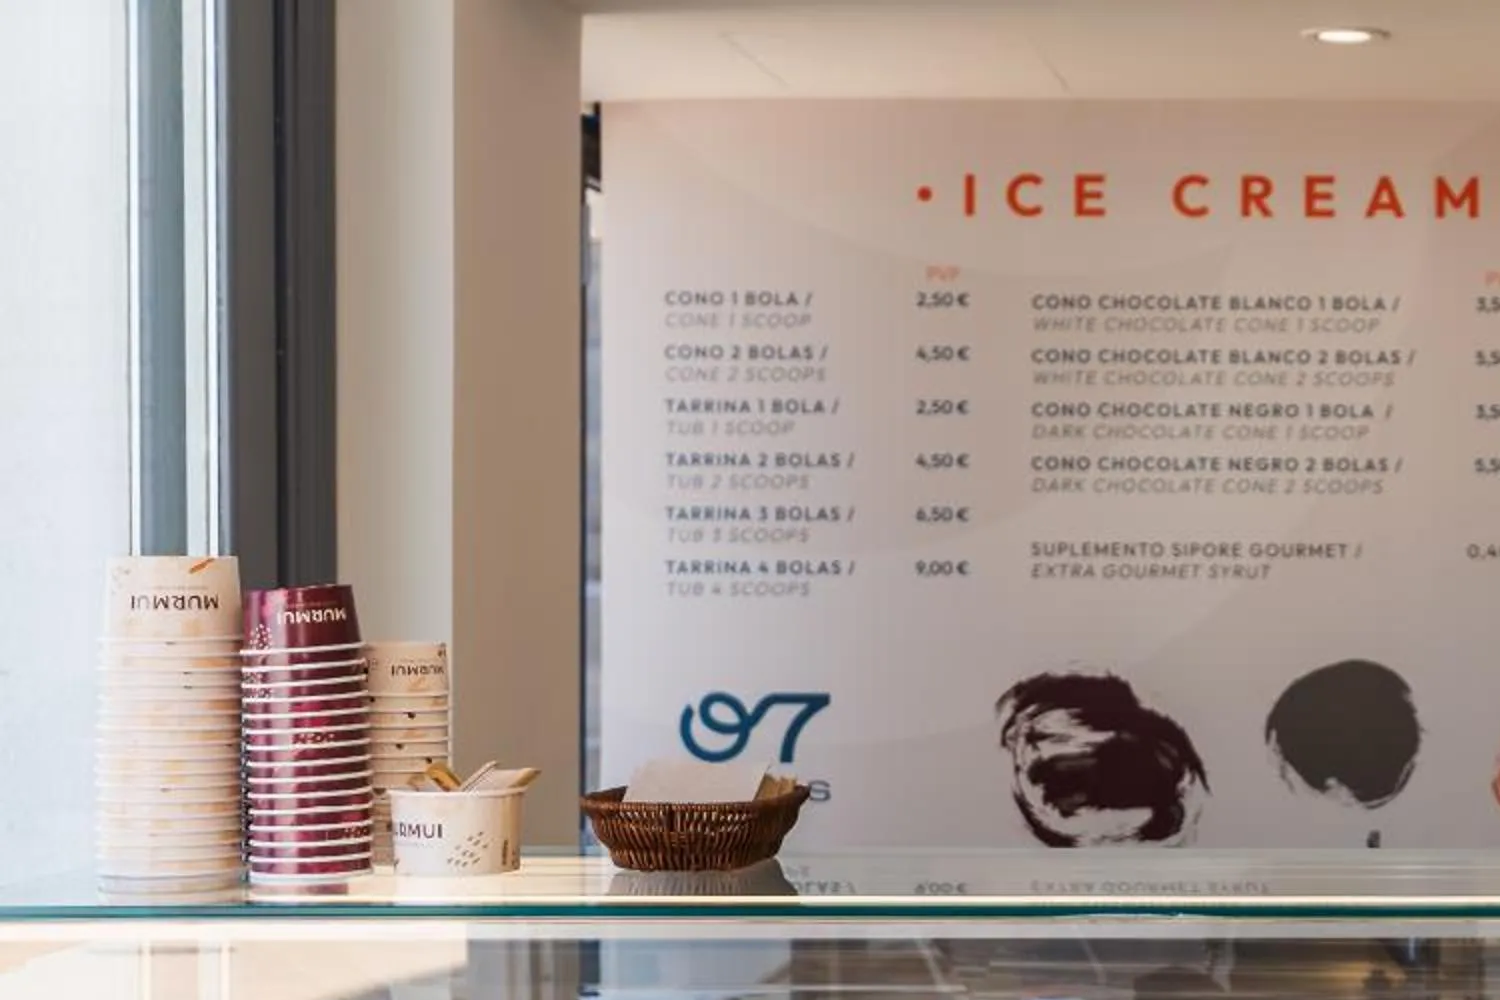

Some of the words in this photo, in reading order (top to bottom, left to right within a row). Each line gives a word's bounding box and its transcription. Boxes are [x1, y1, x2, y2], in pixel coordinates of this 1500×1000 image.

[962, 173, 1107, 218] ICE
[663, 290, 725, 306] CONO
[743, 291, 800, 306] BOLA
[1031, 294, 1093, 310] CONO
[1097, 294, 1222, 311] CHOCOLATE
[1228, 295, 1313, 311] BLANCO
[1331, 296, 1387, 312] BOLA
[663, 312, 720, 328] CONE
[741, 312, 813, 329] SCOOP
[1032, 316, 1098, 332] WHITE
[1103, 316, 1226, 333] CHOCOLATE
[1233, 317, 1289, 333] CONE
[1309, 317, 1381, 333] SCOOP
[663, 345, 725, 360] CONO
[730, 345, 742, 360] 2
[747, 345, 814, 361] BOLAS
[1029, 348, 1092, 365] CONO
[1097, 349, 1222, 365] CHOCOLATE
[1228, 349, 1312, 365] BLANCO
[1317, 350, 1329, 365] 2
[1334, 350, 1402, 365] BOLAS
[663, 366, 720, 382] CONE
[744, 366, 827, 382] SCOOPS
[1032, 369, 1098, 385] WHITE
[1103, 370, 1227, 386] CHOCOLATE
[1233, 370, 1288, 386] CONE
[1312, 370, 1396, 387] SCOOPS
[664, 399, 751, 414] TARRINA
[770, 399, 826, 414] BOLA
[1030, 402, 1092, 418] CONO
[1096, 402, 1222, 418] CHOCOLATE
[1228, 403, 1300, 418] NEGRO
[1319, 403, 1375, 419] BOLA
[665, 419, 705, 435] TUB
[724, 419, 796, 436] SCOOP
[1030, 424, 1086, 439] DARK
[1092, 423, 1216, 440] CHOCOLATE
[1221, 424, 1279, 440] CONE
[1298, 424, 1371, 441] SCOOP
[665, 452, 752, 467] TARRINA
[757, 453, 769, 468] 2
[774, 452, 842, 468] BOLAS
[1030, 456, 1092, 472] CONO
[1096, 456, 1221, 472] CHOCOLATE
[1227, 457, 1300, 472] NEGRO
[1305, 457, 1317, 473] 2
[1322, 457, 1389, 473] BOLAS
[666, 473, 705, 490] TUB
[729, 473, 810, 490] SCOOPS
[1030, 477, 1086, 493] DARK
[1091, 477, 1216, 494] CHOCOLATE
[1221, 478, 1279, 495] CONE
[1302, 478, 1384, 495] SCOOPS
[664, 506, 752, 521] TARRINA
[758, 506, 769, 522] 3
[774, 506, 841, 522] BOLAS
[667, 527, 705, 543] TUB
[728, 527, 811, 543] SCOOPS
[1030, 541, 1166, 558] SUPLEMENTO
[1170, 542, 1242, 558] SIPORE
[1248, 543, 1349, 559] GOURMET
[664, 560, 752, 575] TARRINA
[757, 560, 769, 574] 4
[775, 560, 842, 575] BOLAS
[1030, 563, 1097, 579] EXTRA
[1101, 563, 1202, 580] GOURMET
[666, 581, 706, 597] TUB
[729, 581, 811, 597] SCOOPS
[131, 594, 219, 610] MURMUI
[276, 608, 347, 625] MURMUI
[395, 822, 443, 839] RMUI
